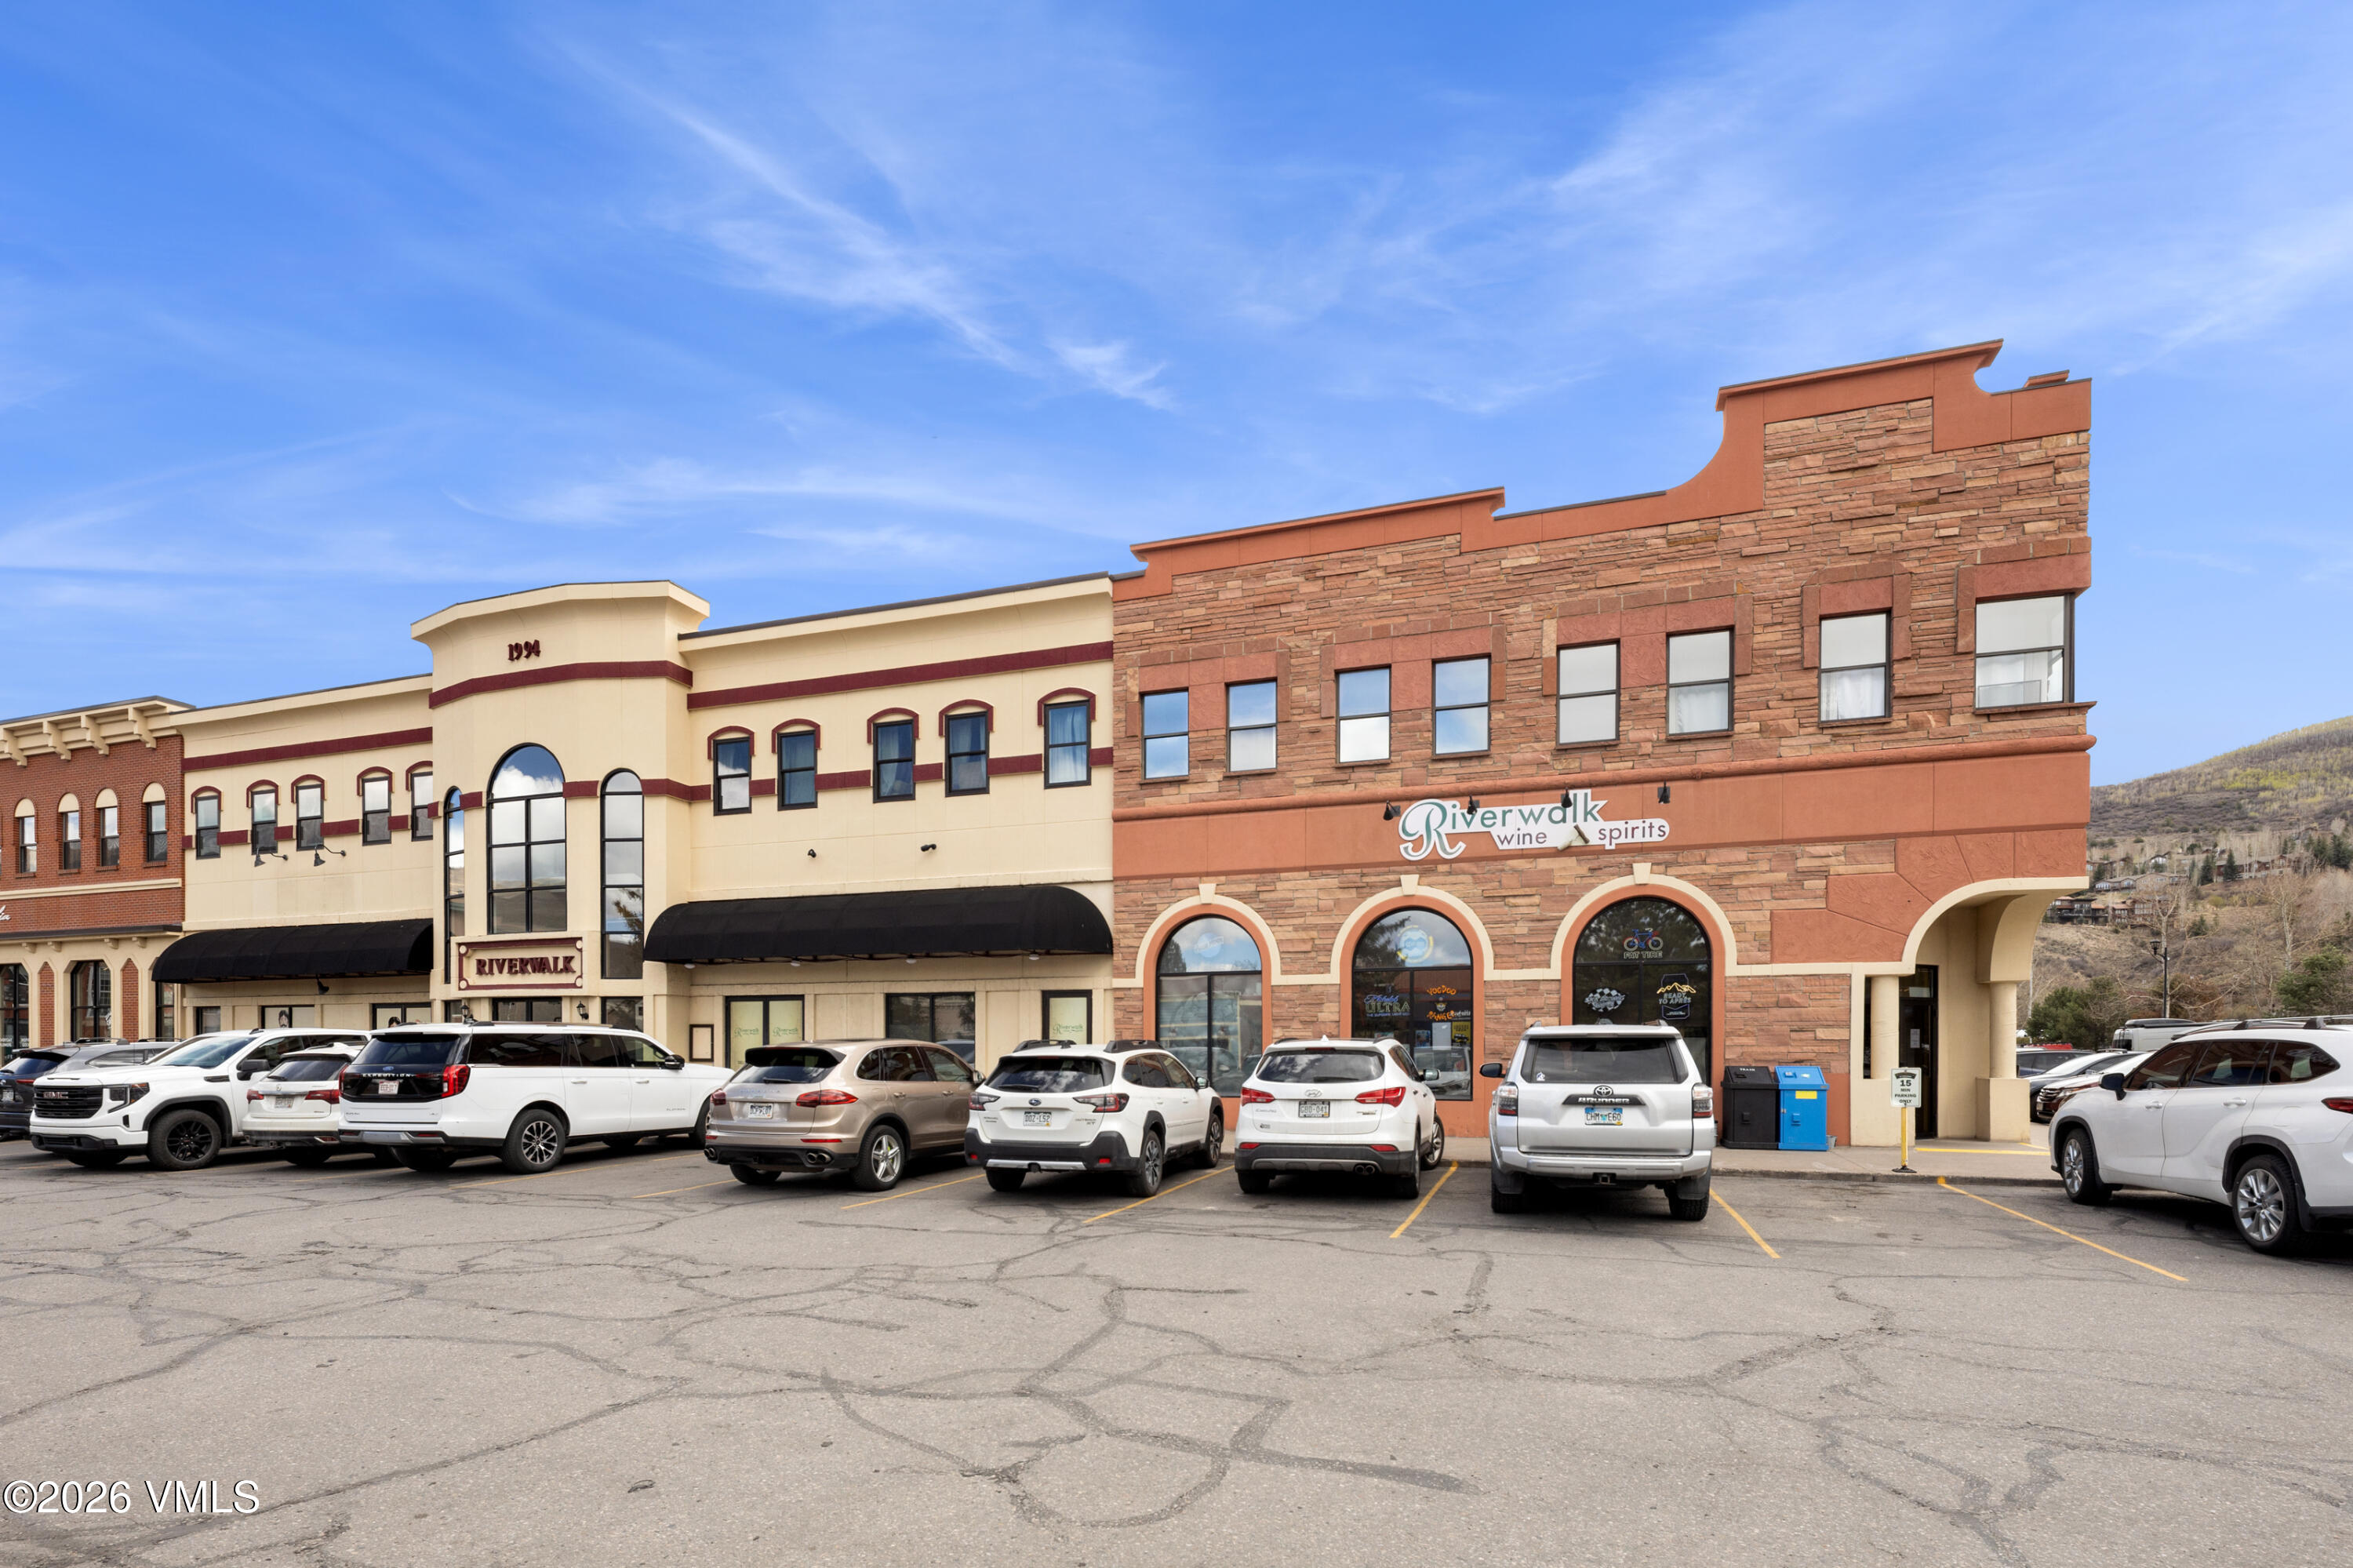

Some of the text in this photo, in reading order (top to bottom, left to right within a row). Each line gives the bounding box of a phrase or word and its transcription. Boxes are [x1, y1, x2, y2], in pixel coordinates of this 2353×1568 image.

[507, 639, 541, 661] 1994
[1401, 791, 1601, 857] Riverwalk
[1497, 820, 1667, 846] wine spirits
[475, 955, 576, 976] RIVERWALK
[1365, 1001, 1411, 1013] ULTRA
